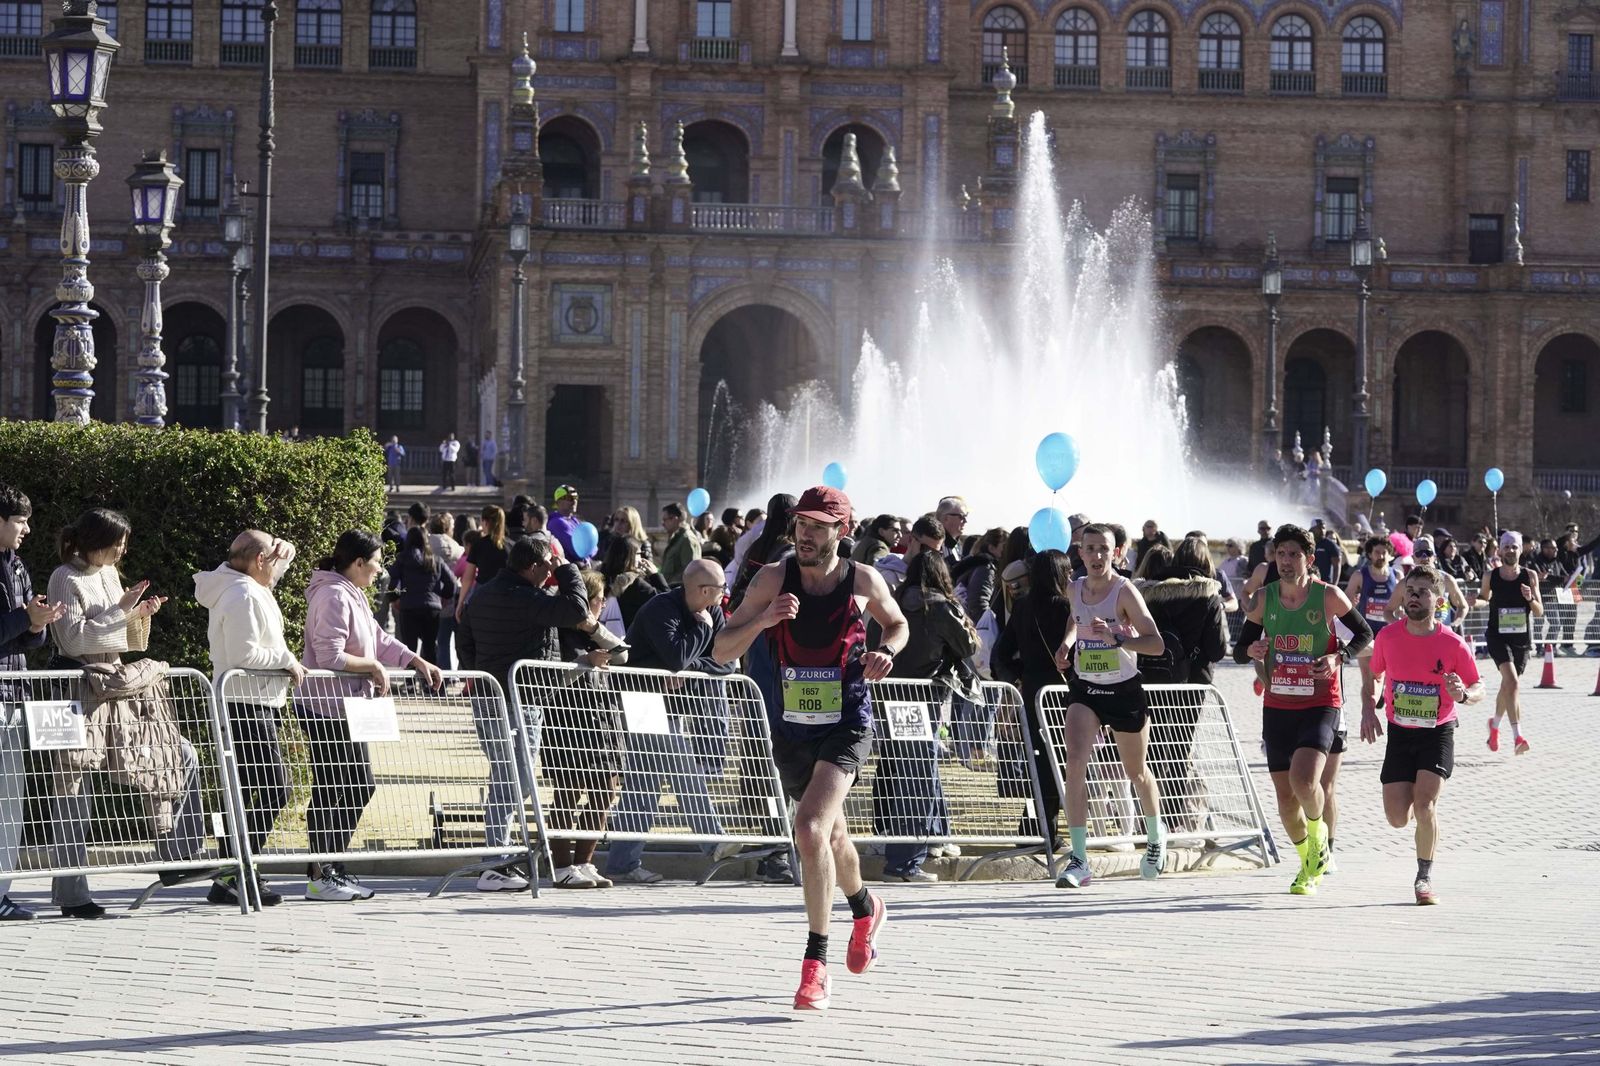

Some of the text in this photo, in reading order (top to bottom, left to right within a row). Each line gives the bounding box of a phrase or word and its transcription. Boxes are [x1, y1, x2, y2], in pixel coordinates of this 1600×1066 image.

[1274, 634, 1313, 651] ADN
[1085, 662, 1109, 671] AITOR
[800, 670, 835, 679] ZURICH
[1271, 677, 1291, 685] LUCAS
[1298, 678, 1314, 686] INES
[801, 687, 820, 696] 1657
[798, 698, 822, 711] ROB
[42, 707, 73, 727] AMS
[896, 706, 919, 723] AMS
